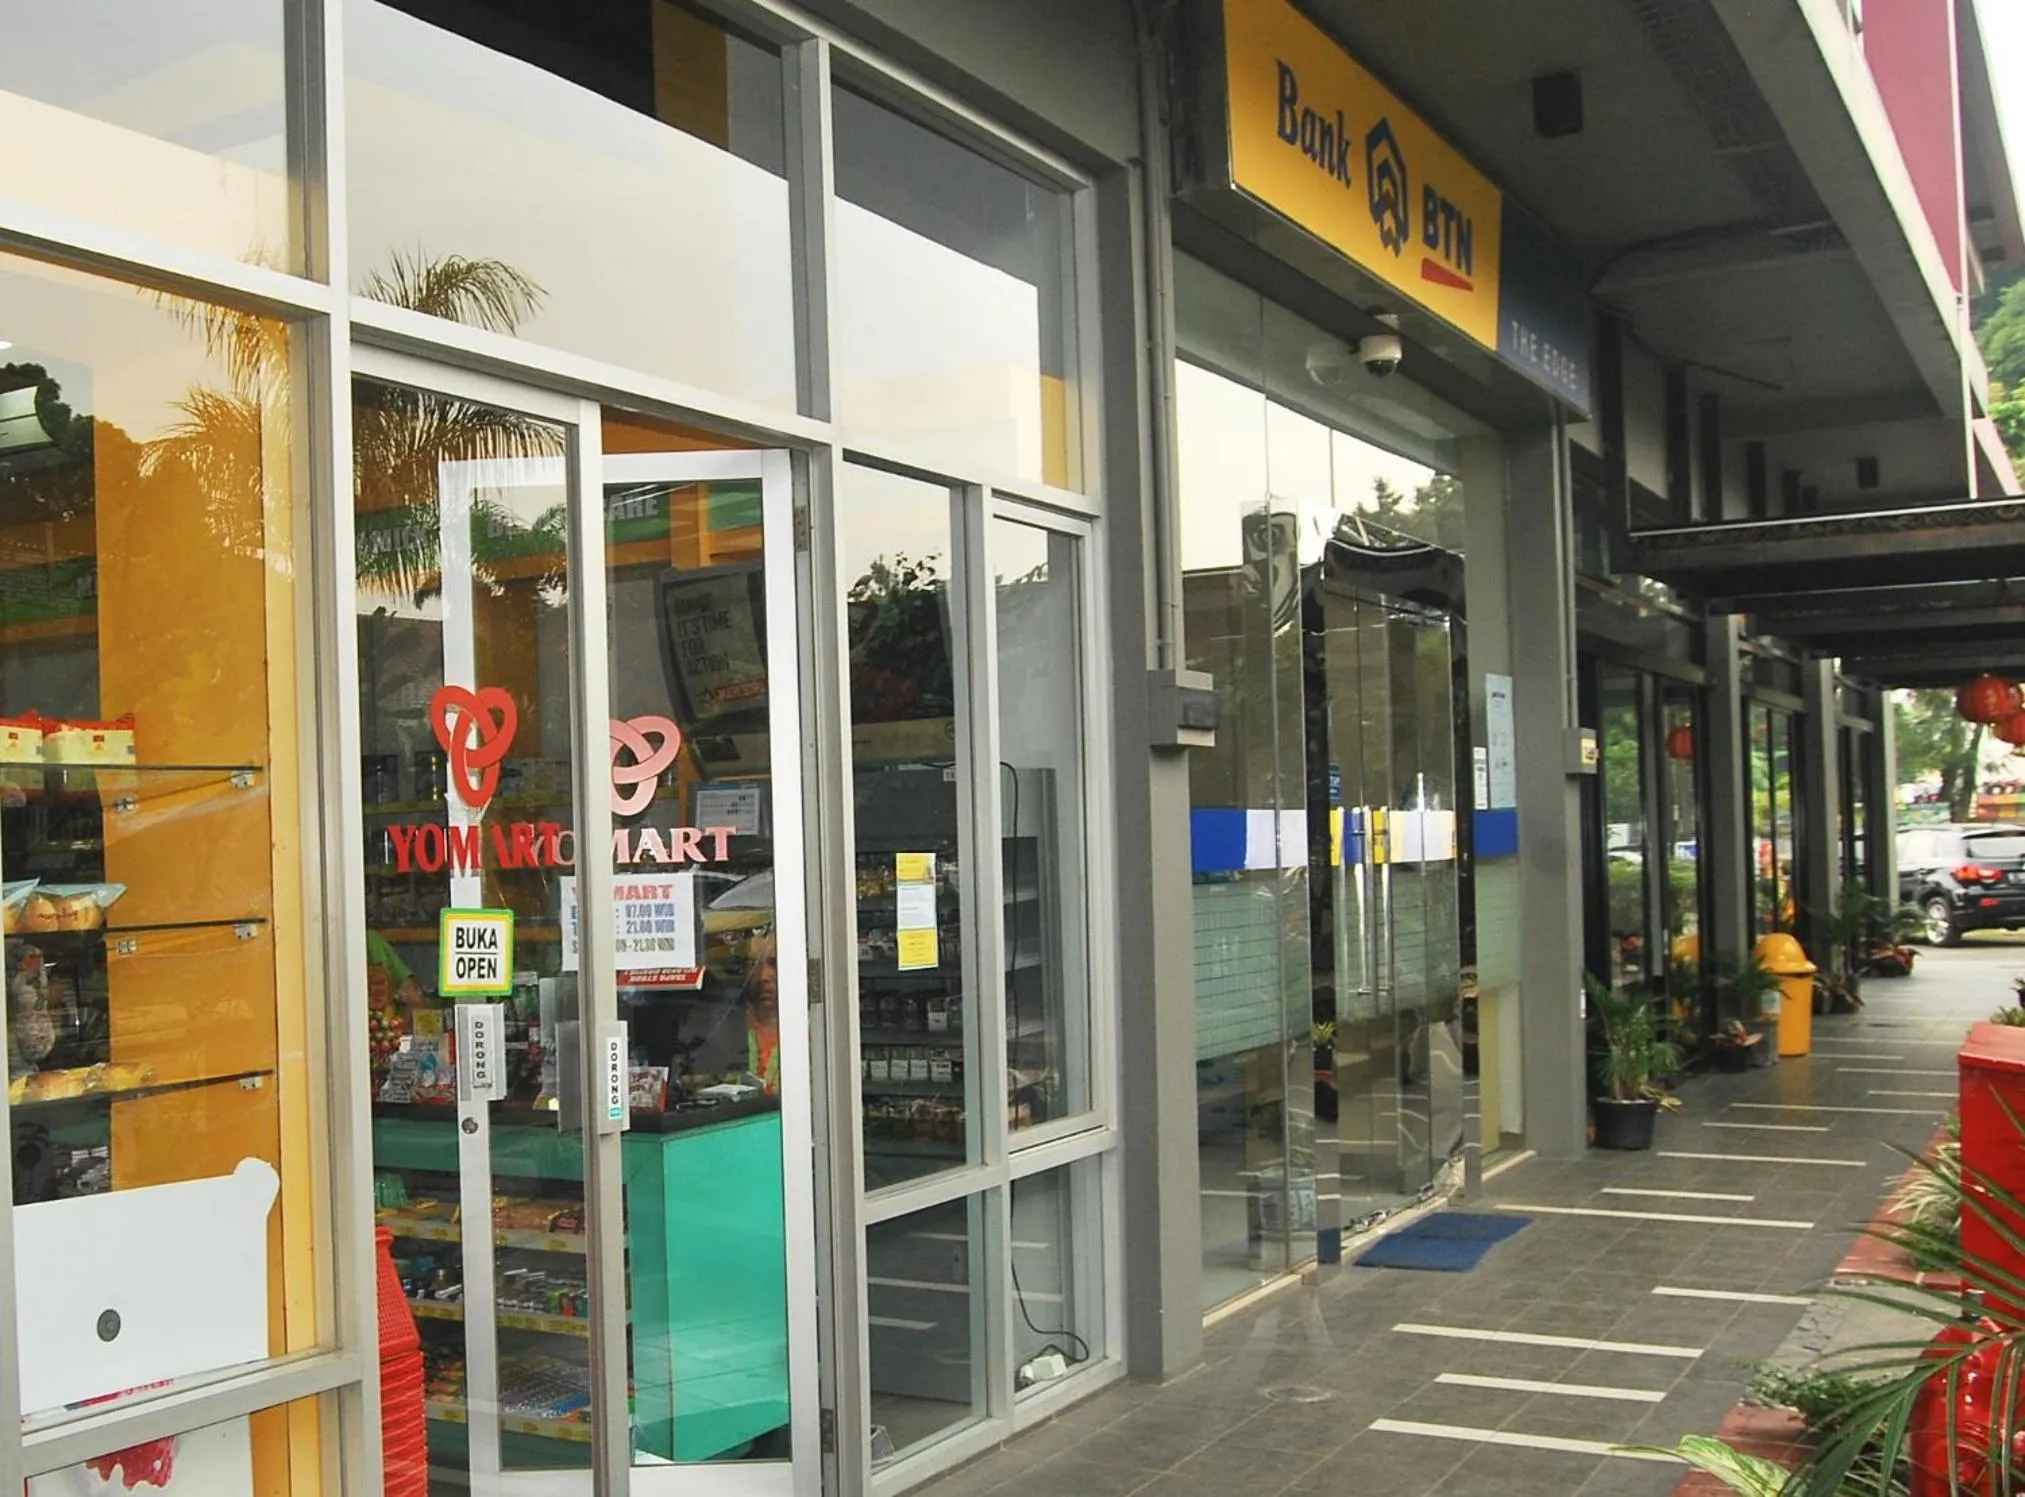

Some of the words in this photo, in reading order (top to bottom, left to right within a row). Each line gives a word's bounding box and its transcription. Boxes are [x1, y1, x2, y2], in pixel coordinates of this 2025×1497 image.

[1276, 58, 1351, 190] Bank
[1423, 183, 1473, 276] BTN
[1511, 320, 1538, 362] THE
[1543, 341, 1578, 389] EDGE
[387, 823, 560, 873] YOMART
[455, 927, 498, 949] BUKA
[456, 957, 497, 979] OPEN
[475, 1021, 486, 1079] DORONG
[611, 1042, 619, 1105] DORONG
